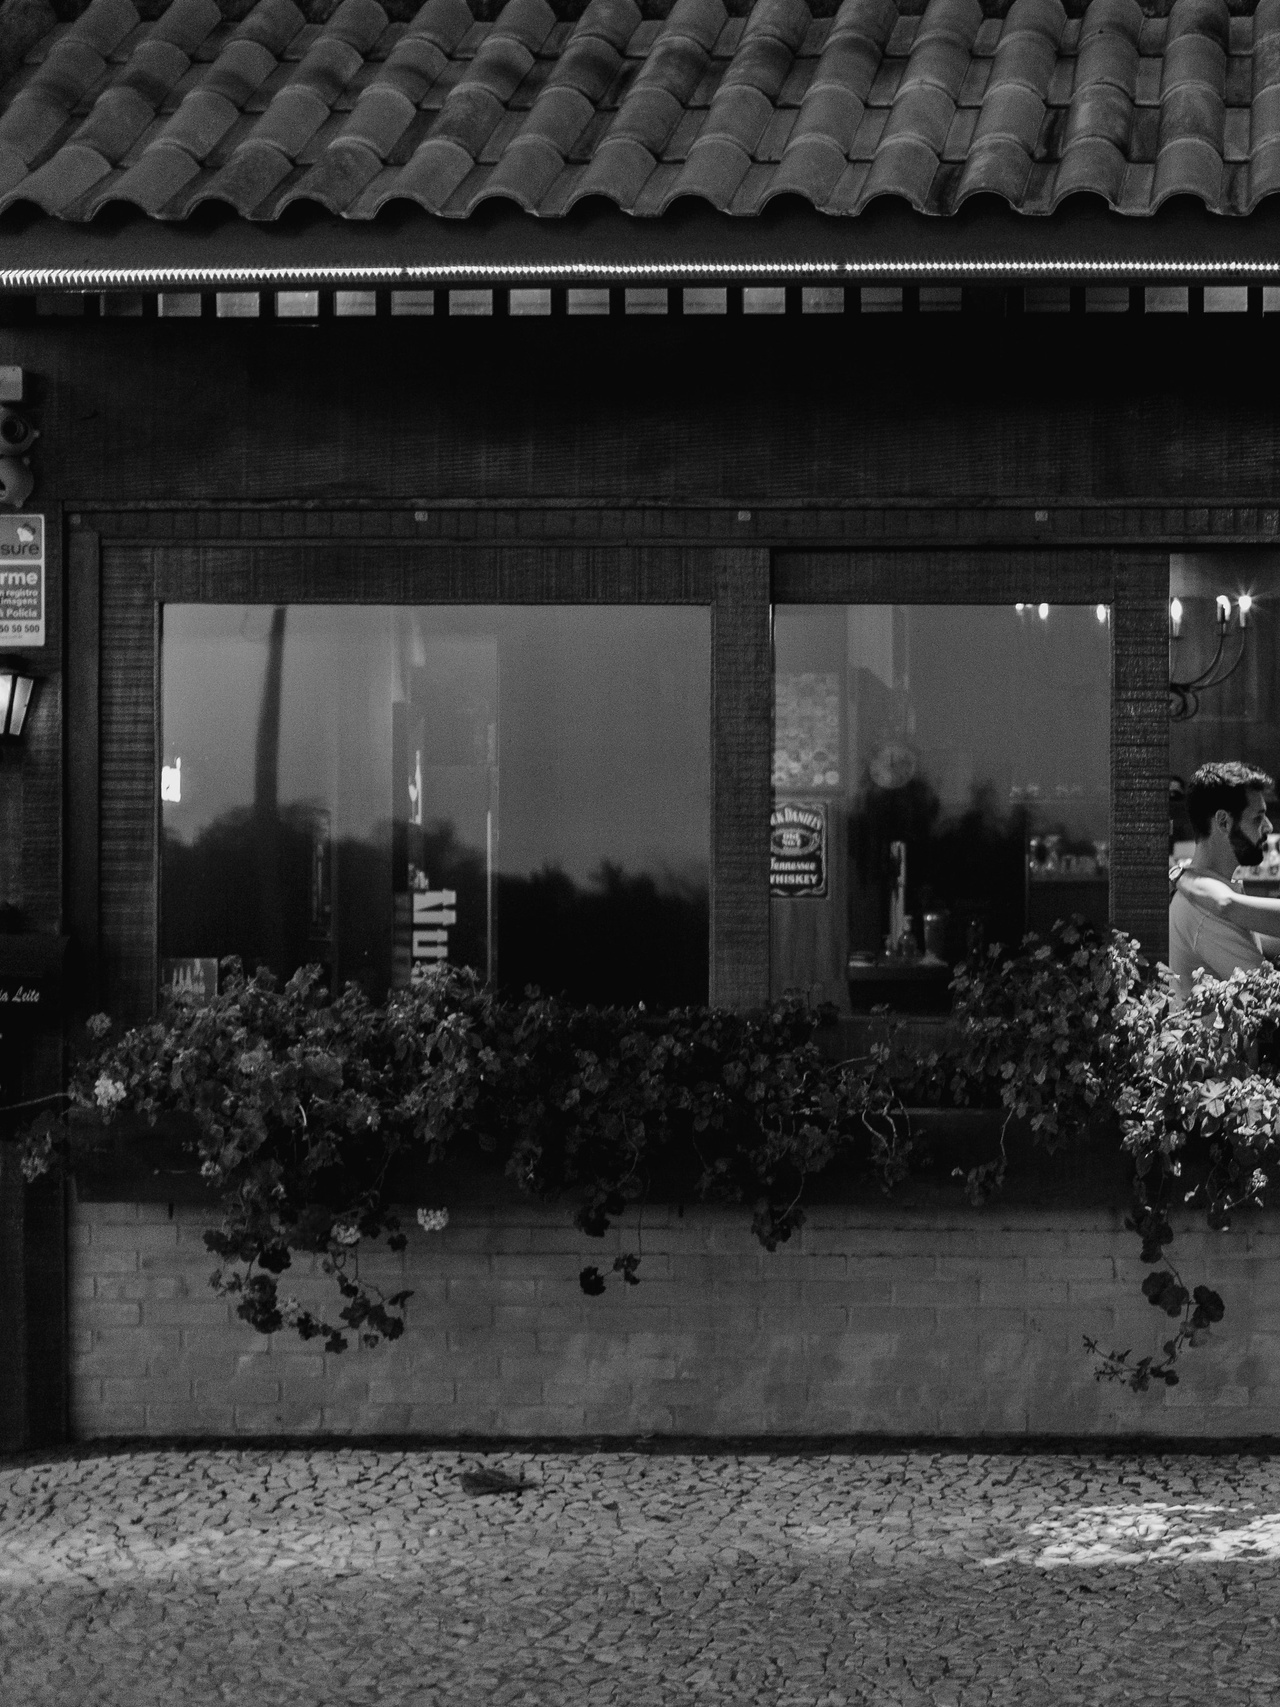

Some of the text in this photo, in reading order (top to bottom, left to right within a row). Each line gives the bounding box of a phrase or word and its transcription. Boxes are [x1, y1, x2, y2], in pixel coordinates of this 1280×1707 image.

[6, 589, 39, 598] registro
[1, 597, 38, 607] imagens
[12, 624, 22, 633] 50
[25, 624, 40, 633] 500
[11, 985, 40, 1003] Leite
